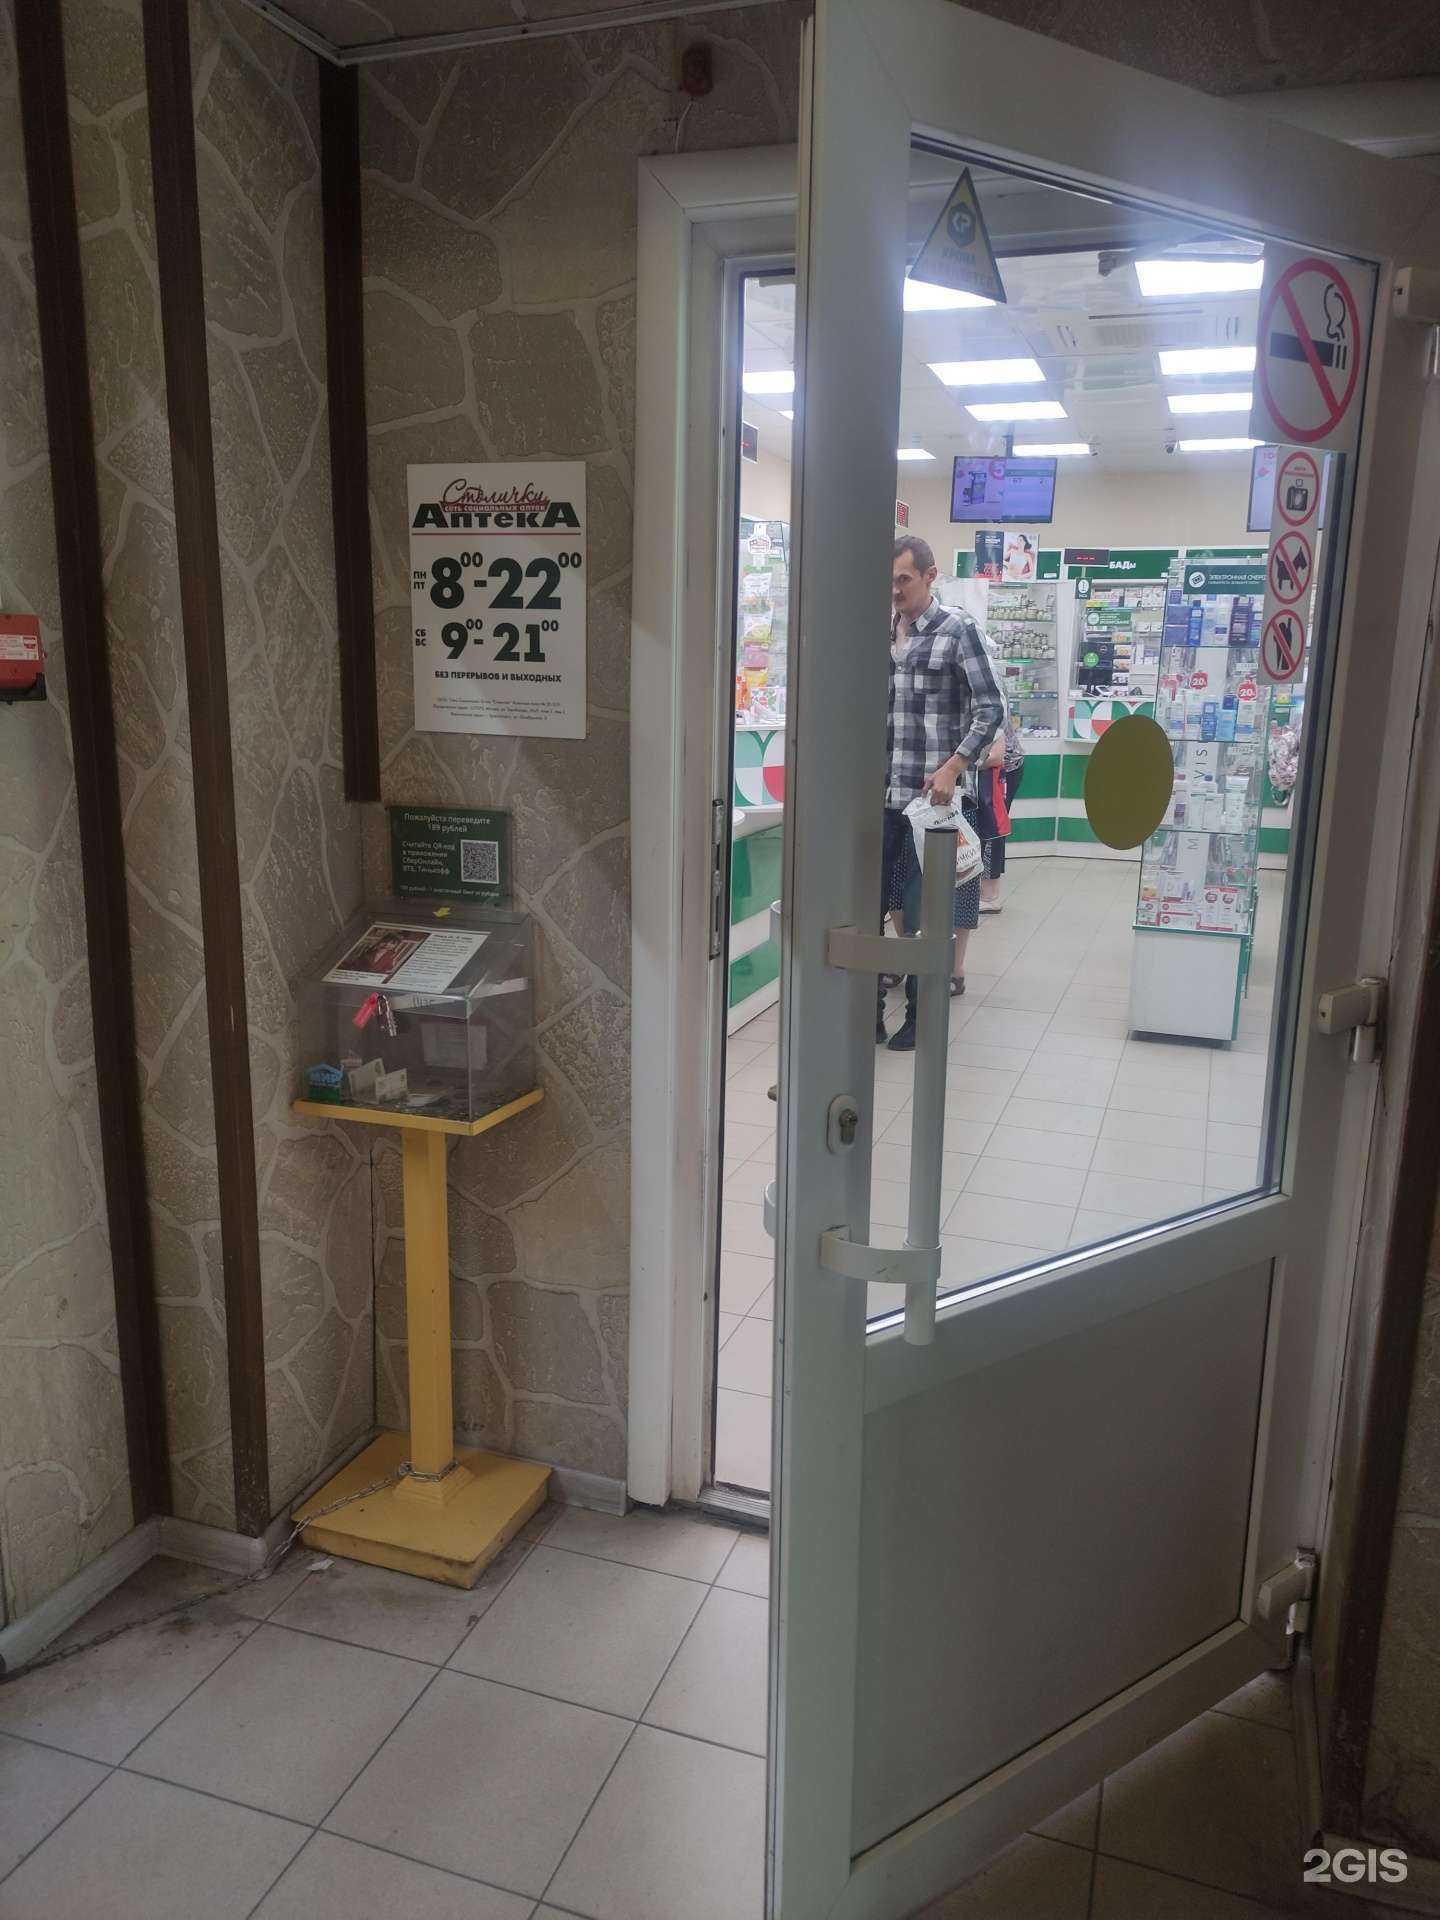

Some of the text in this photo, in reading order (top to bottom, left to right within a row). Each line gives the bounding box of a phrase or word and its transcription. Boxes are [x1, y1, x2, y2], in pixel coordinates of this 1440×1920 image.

[443, 478, 547, 505] Столички
[464, 505, 518, 513] социальных
[1109, 560, 1137, 570] БАДы
[434, 670, 562, 683] БЕЗ ПЕРЕРЫВОВ И ВЫХОДНЫХ
[448, 816, 491, 826] переведите
[442, 824, 468, 834] рублей
